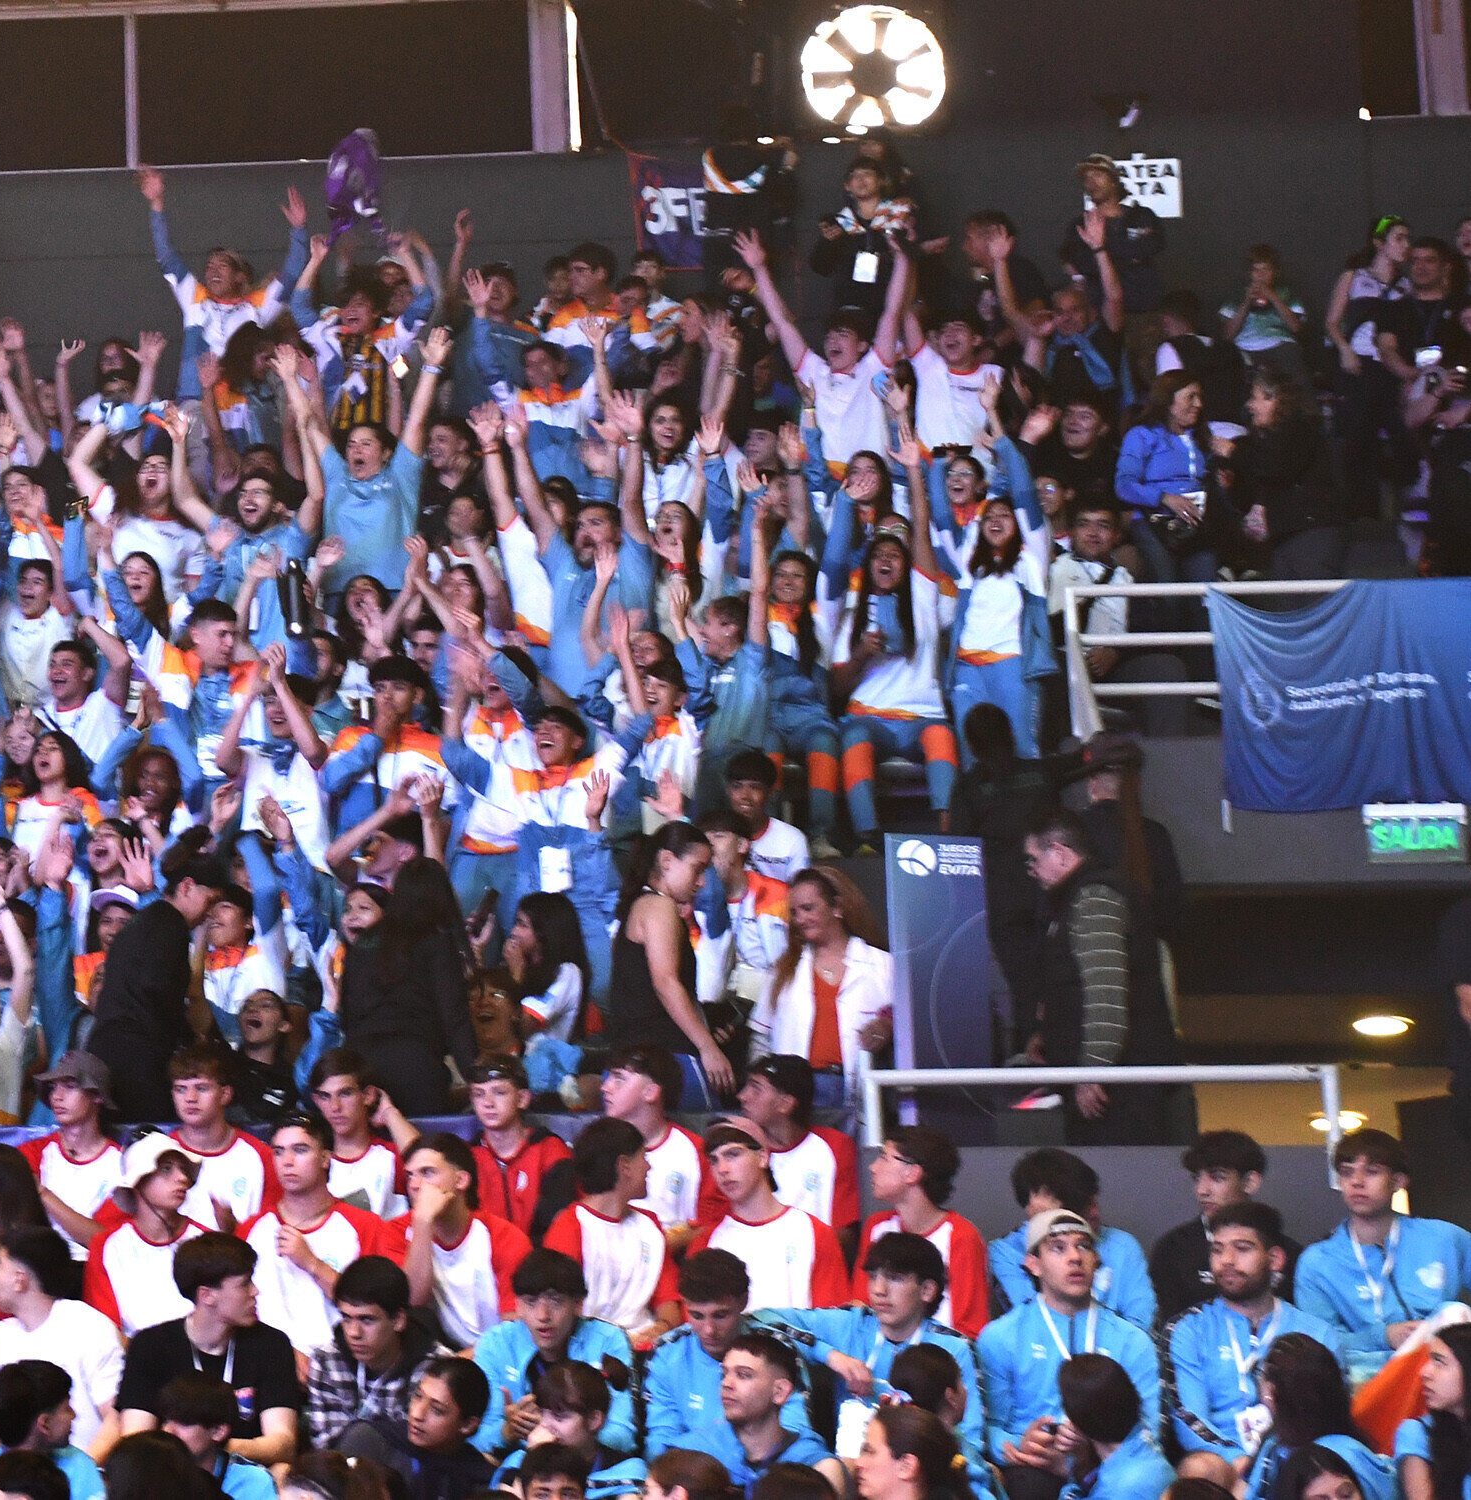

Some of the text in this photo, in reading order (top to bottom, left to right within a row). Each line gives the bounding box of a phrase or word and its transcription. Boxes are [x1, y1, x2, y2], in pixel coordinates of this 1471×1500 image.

[1116, 164, 1175, 178] ATEA
[1127, 182, 1166, 195] TA
[1373, 824, 1458, 851] SALIDA
